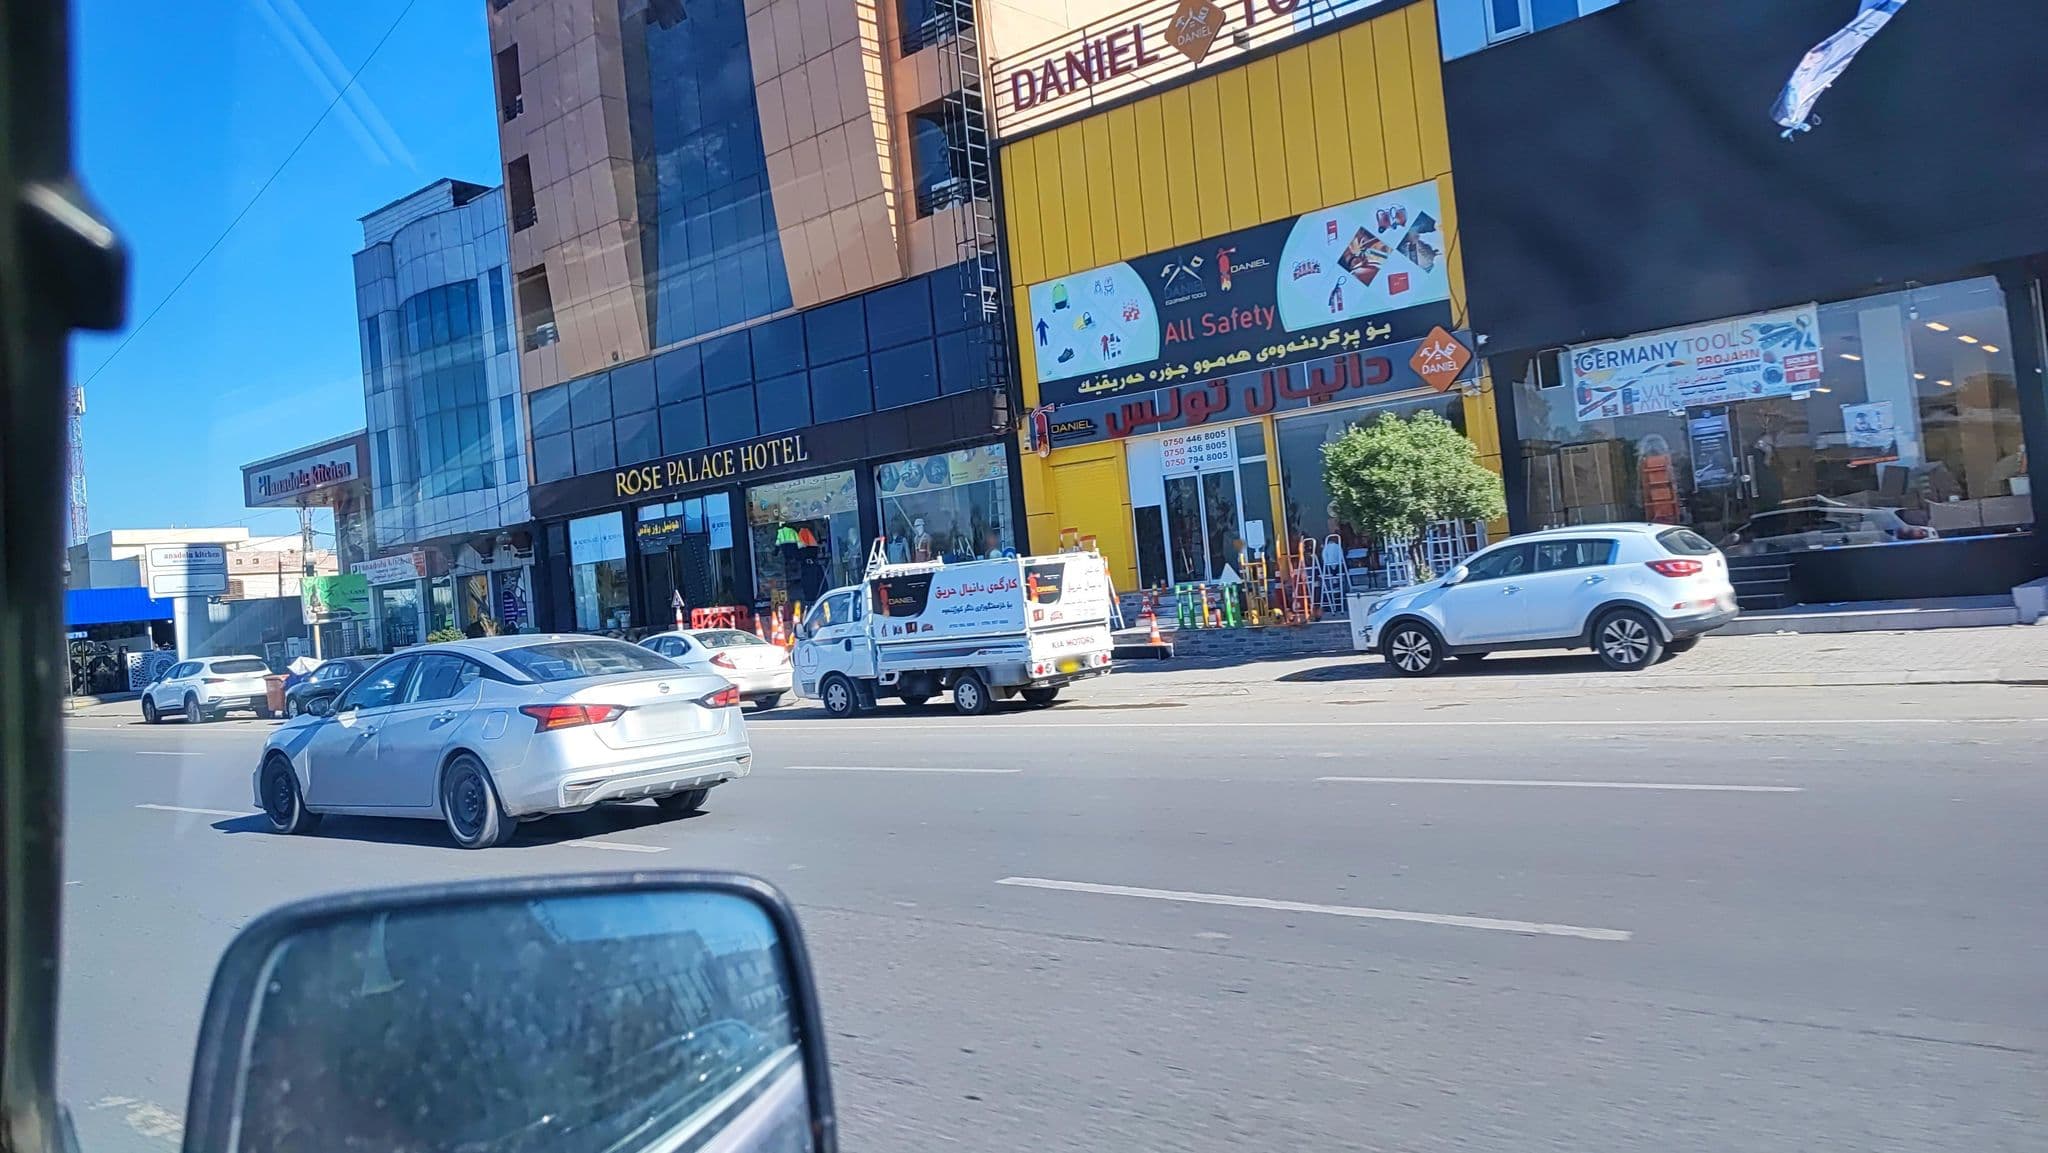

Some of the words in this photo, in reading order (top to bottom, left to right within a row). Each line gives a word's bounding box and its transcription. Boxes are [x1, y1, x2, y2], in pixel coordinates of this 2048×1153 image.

[1177, 25, 1213, 47] DANIEL
[1011, 23, 1160, 113] DANIEL
[1231, 259, 1270, 273] DANIEL
[1165, 317, 1195, 345] All
[1202, 304, 1275, 336] Safety
[1366, 321, 1391, 340] بۆ
[1580, 340, 1679, 371] GERMANY
[1682, 328, 1754, 354] TOOLS
[1193, 350, 1252, 374] هەموو
[1696, 350, 1761, 366] PROJAHN
[1422, 360, 1459, 375] DANIEL
[1050, 420, 1094, 434] DANIEL
[1163, 437, 1184, 447] 0750
[1186, 434, 1202, 443] 446
[1204, 430, 1226, 440] 8005
[1164, 447, 1185, 457] 0750
[1187, 444, 1203, 453] 436
[1205, 441, 1227, 451] 8005
[616, 465, 663, 497] ROSE
[667, 449, 735, 485] PALACE
[741, 434, 808, 472] HOTEL
[1165, 458, 1186, 467] 0750
[1188, 455, 1204, 463] 794
[1206, 451, 1228, 461] 8005
[194, 550, 220, 559] kitchen
[888, 597, 917, 606] DANIEL
[1066, 636, 1095, 647] MOTORS
